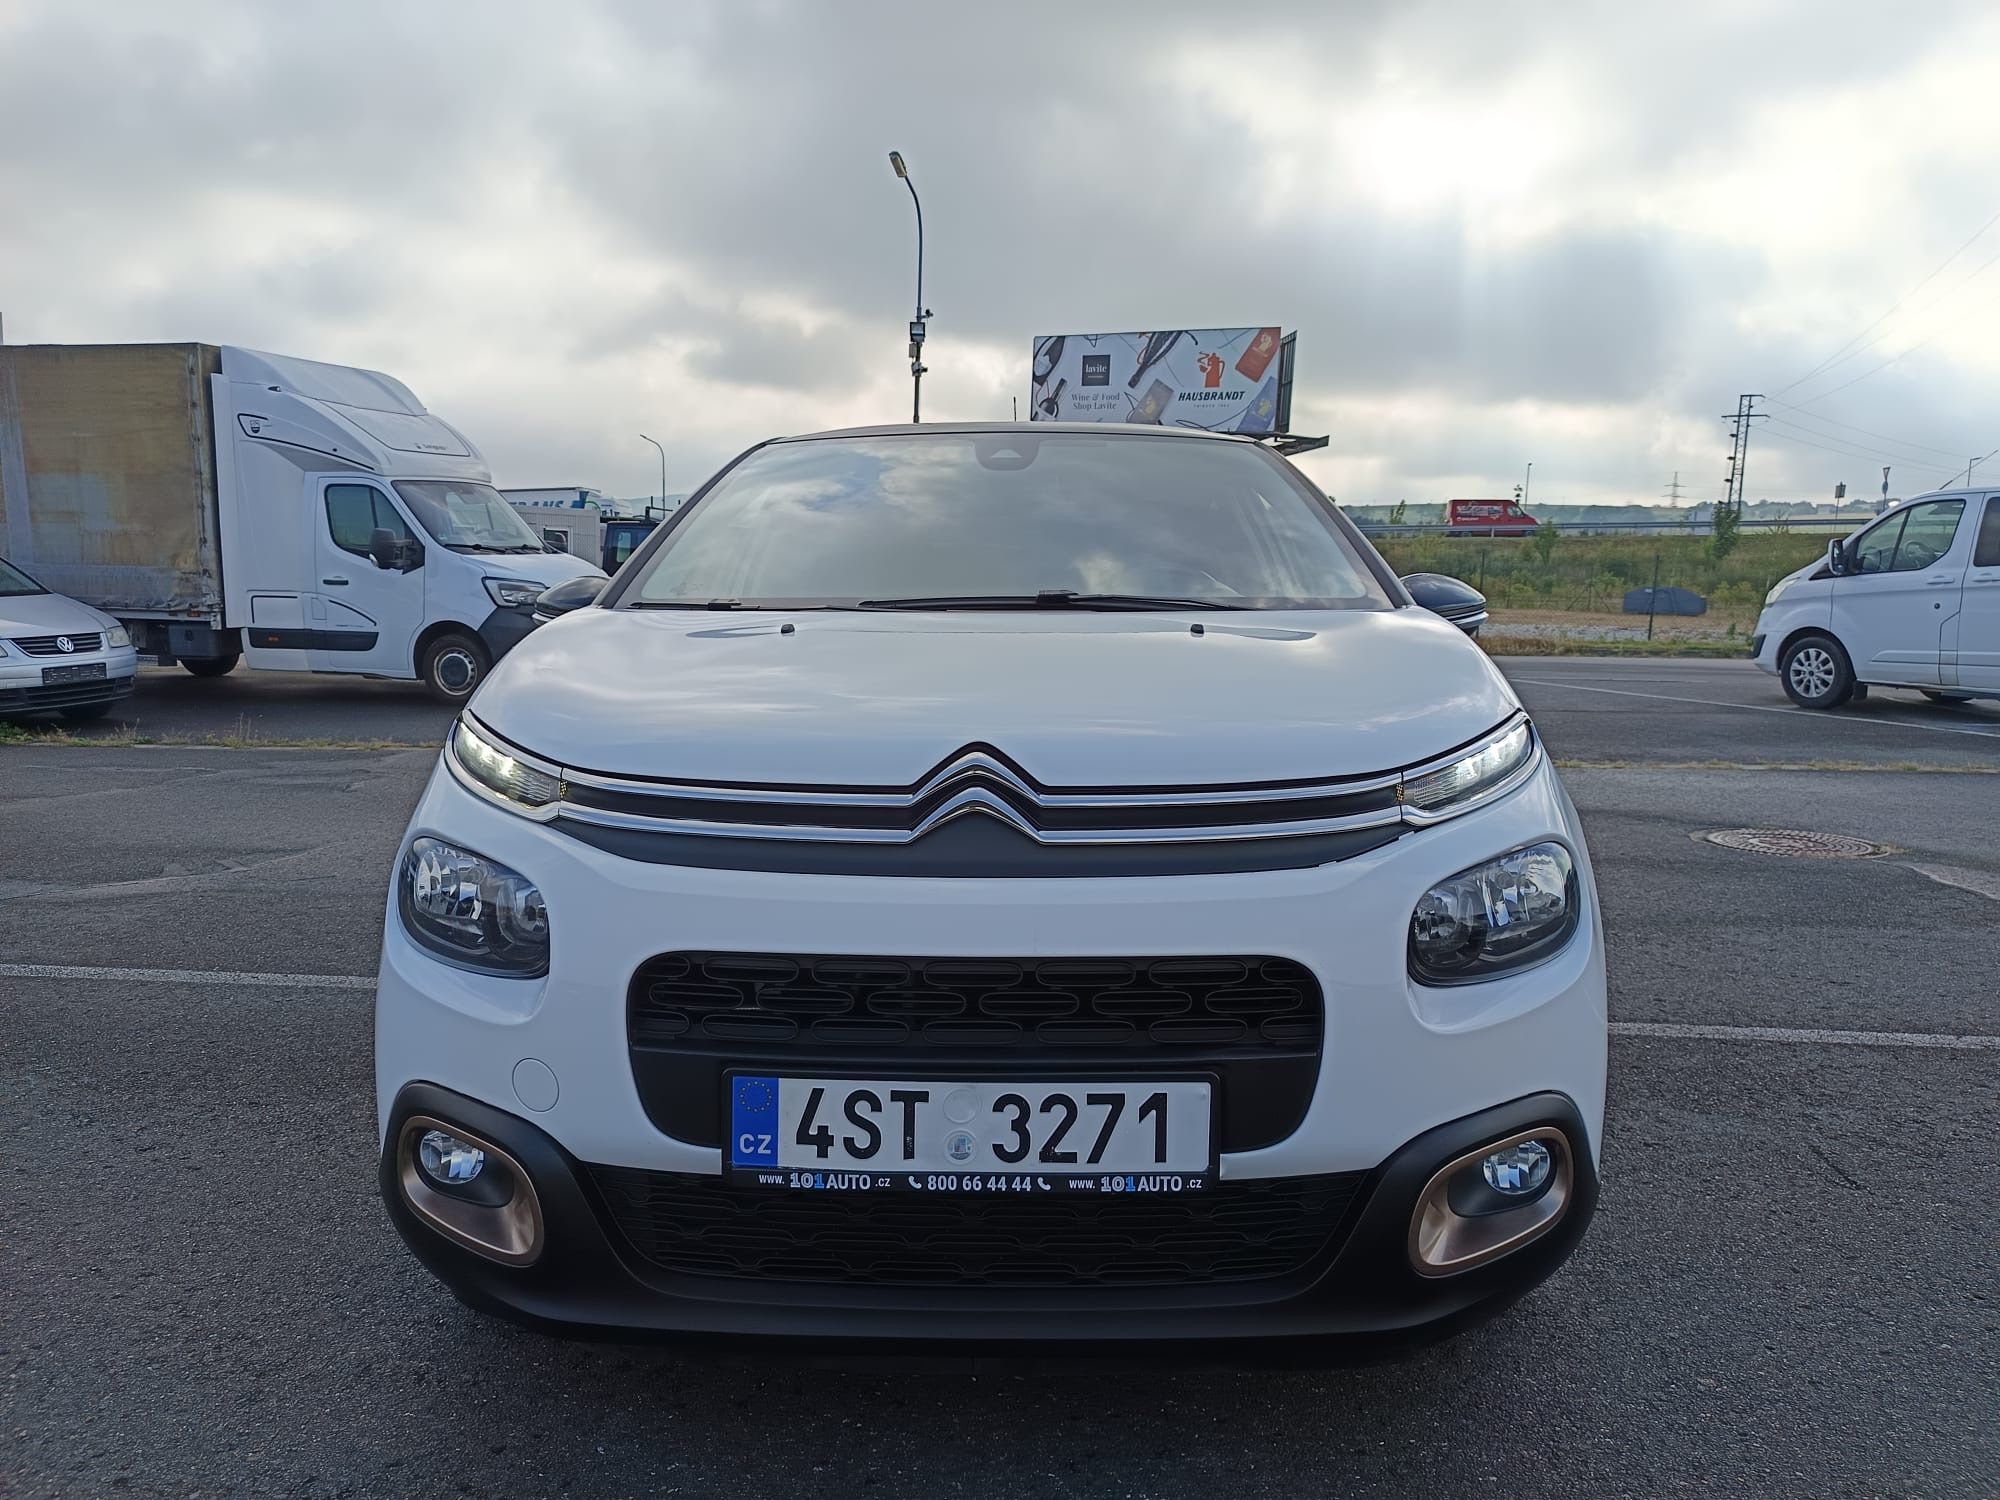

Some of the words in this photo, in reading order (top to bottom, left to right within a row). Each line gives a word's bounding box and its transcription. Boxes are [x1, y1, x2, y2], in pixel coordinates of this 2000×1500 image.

[1085, 363, 1107, 373] lavite
[1071, 393, 1090, 401] Wine
[1092, 393, 1100, 401] &
[1101, 392, 1120, 401] Food
[1178, 391, 1246, 401] HAUSBRANDT
[1073, 402, 1092, 411] Shop
[1094, 402, 1117, 410] Lavite
[795, 1087, 930, 1161] 4ST
[992, 1092, 1168, 1164] 3271
[739, 1133, 772, 1154] CZ
[927, 1175, 957, 1191] 800
[962, 1175, 982, 1191] 66
[986, 1175, 1007, 1192] 44
[1011, 1175, 1032, 1192] 44
